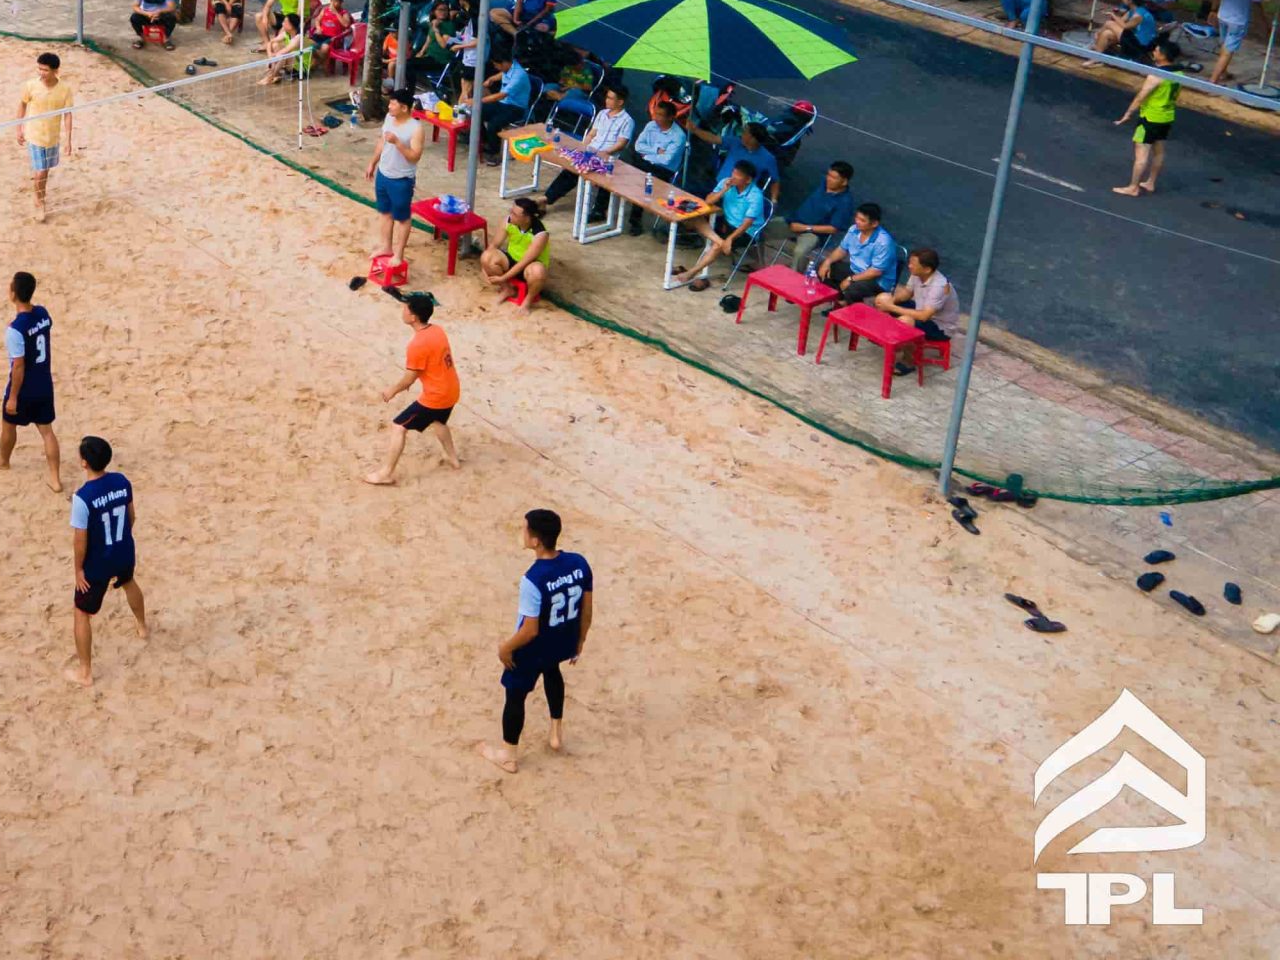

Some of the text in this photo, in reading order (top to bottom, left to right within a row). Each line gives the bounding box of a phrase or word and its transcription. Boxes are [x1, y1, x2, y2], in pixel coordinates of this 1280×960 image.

[35, 334, 46, 364] 9
[101, 505, 126, 546] 17
[548, 585, 583, 627] 22
